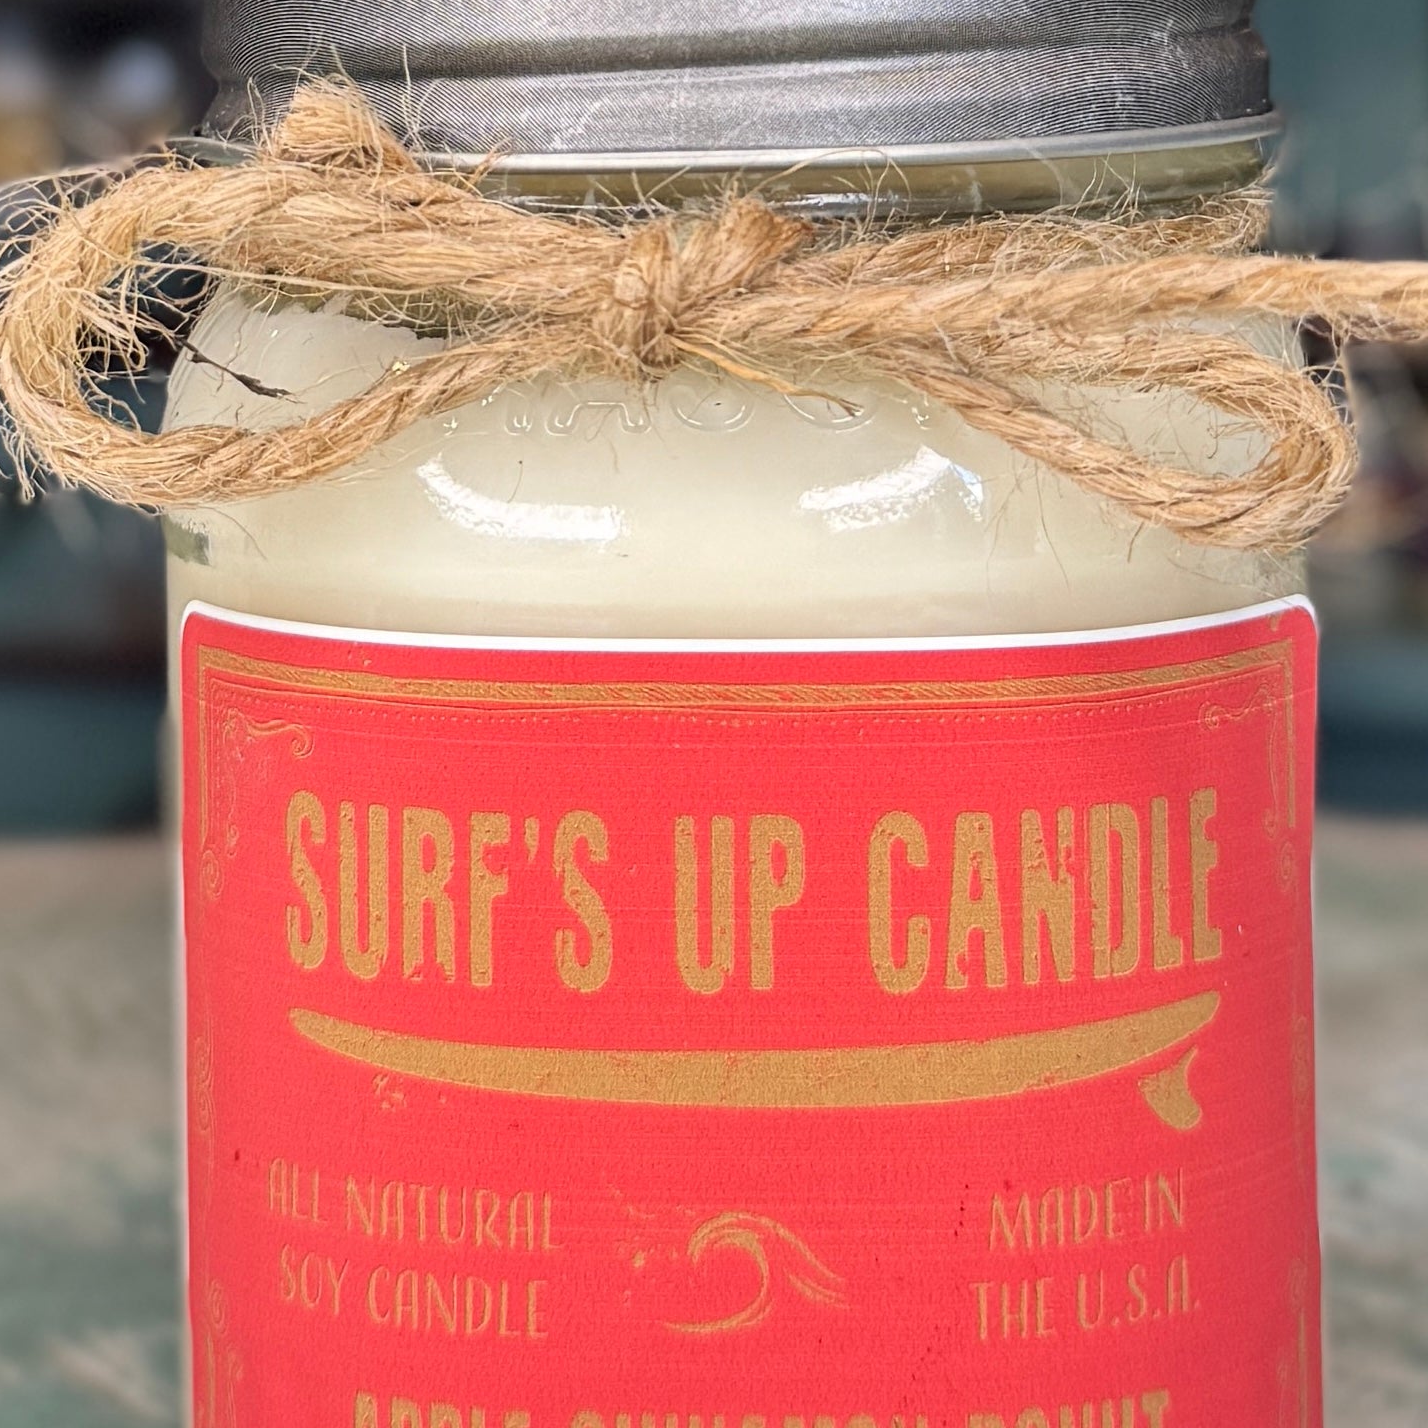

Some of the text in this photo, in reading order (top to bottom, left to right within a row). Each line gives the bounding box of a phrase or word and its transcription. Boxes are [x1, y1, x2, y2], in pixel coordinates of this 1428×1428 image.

[285, 786, 1224, 996] SURF'S UP CANDLE
[267, 1156, 562, 1252] ALL NATURAL
[987, 1167, 1187, 1250] MADE IN
[278, 1243, 550, 1339] SOY CANDLE
[970, 1256, 1201, 1342] THE U.S.A.
